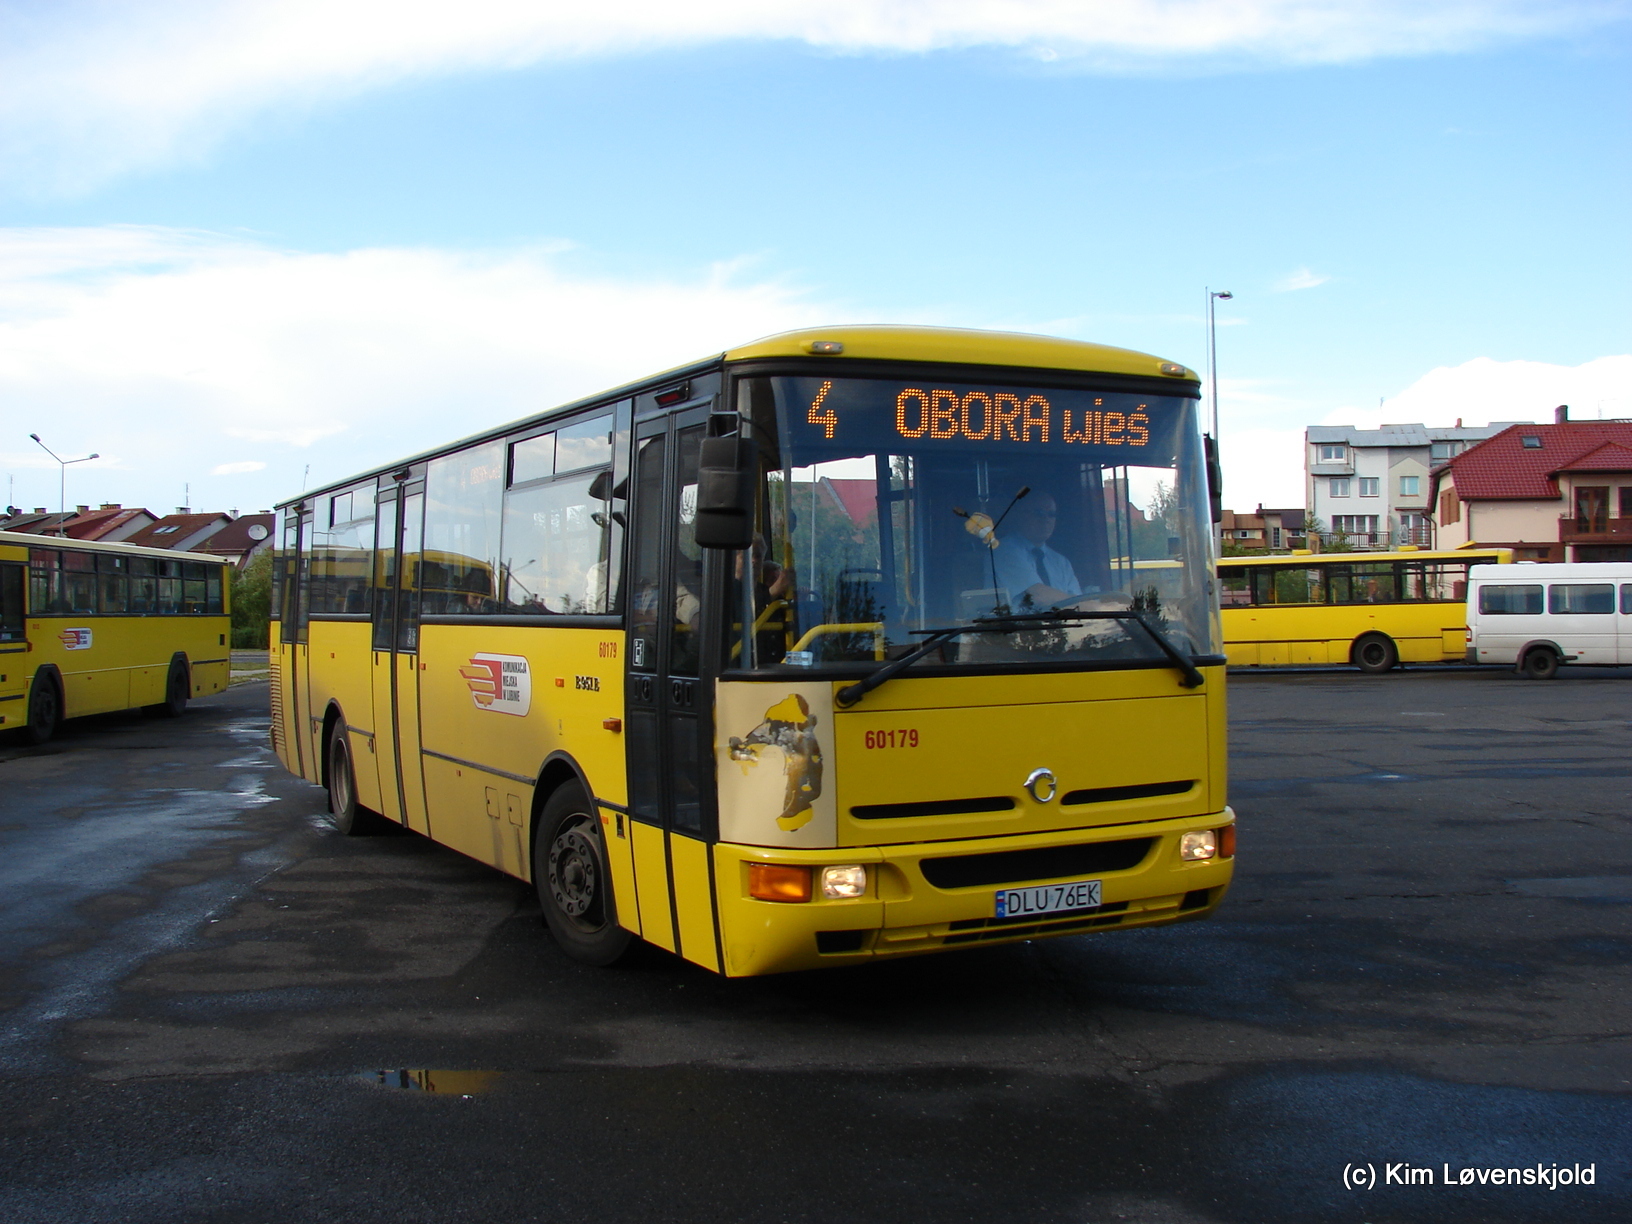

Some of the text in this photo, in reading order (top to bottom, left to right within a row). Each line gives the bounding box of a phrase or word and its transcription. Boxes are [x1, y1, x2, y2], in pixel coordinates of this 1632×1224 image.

[807, 380, 1149, 446] 4 OBORA wieś
[598, 641, 618, 659] 60179
[864, 728, 919, 750] 60179
[1008, 883, 1098, 914] DLU 76EK
